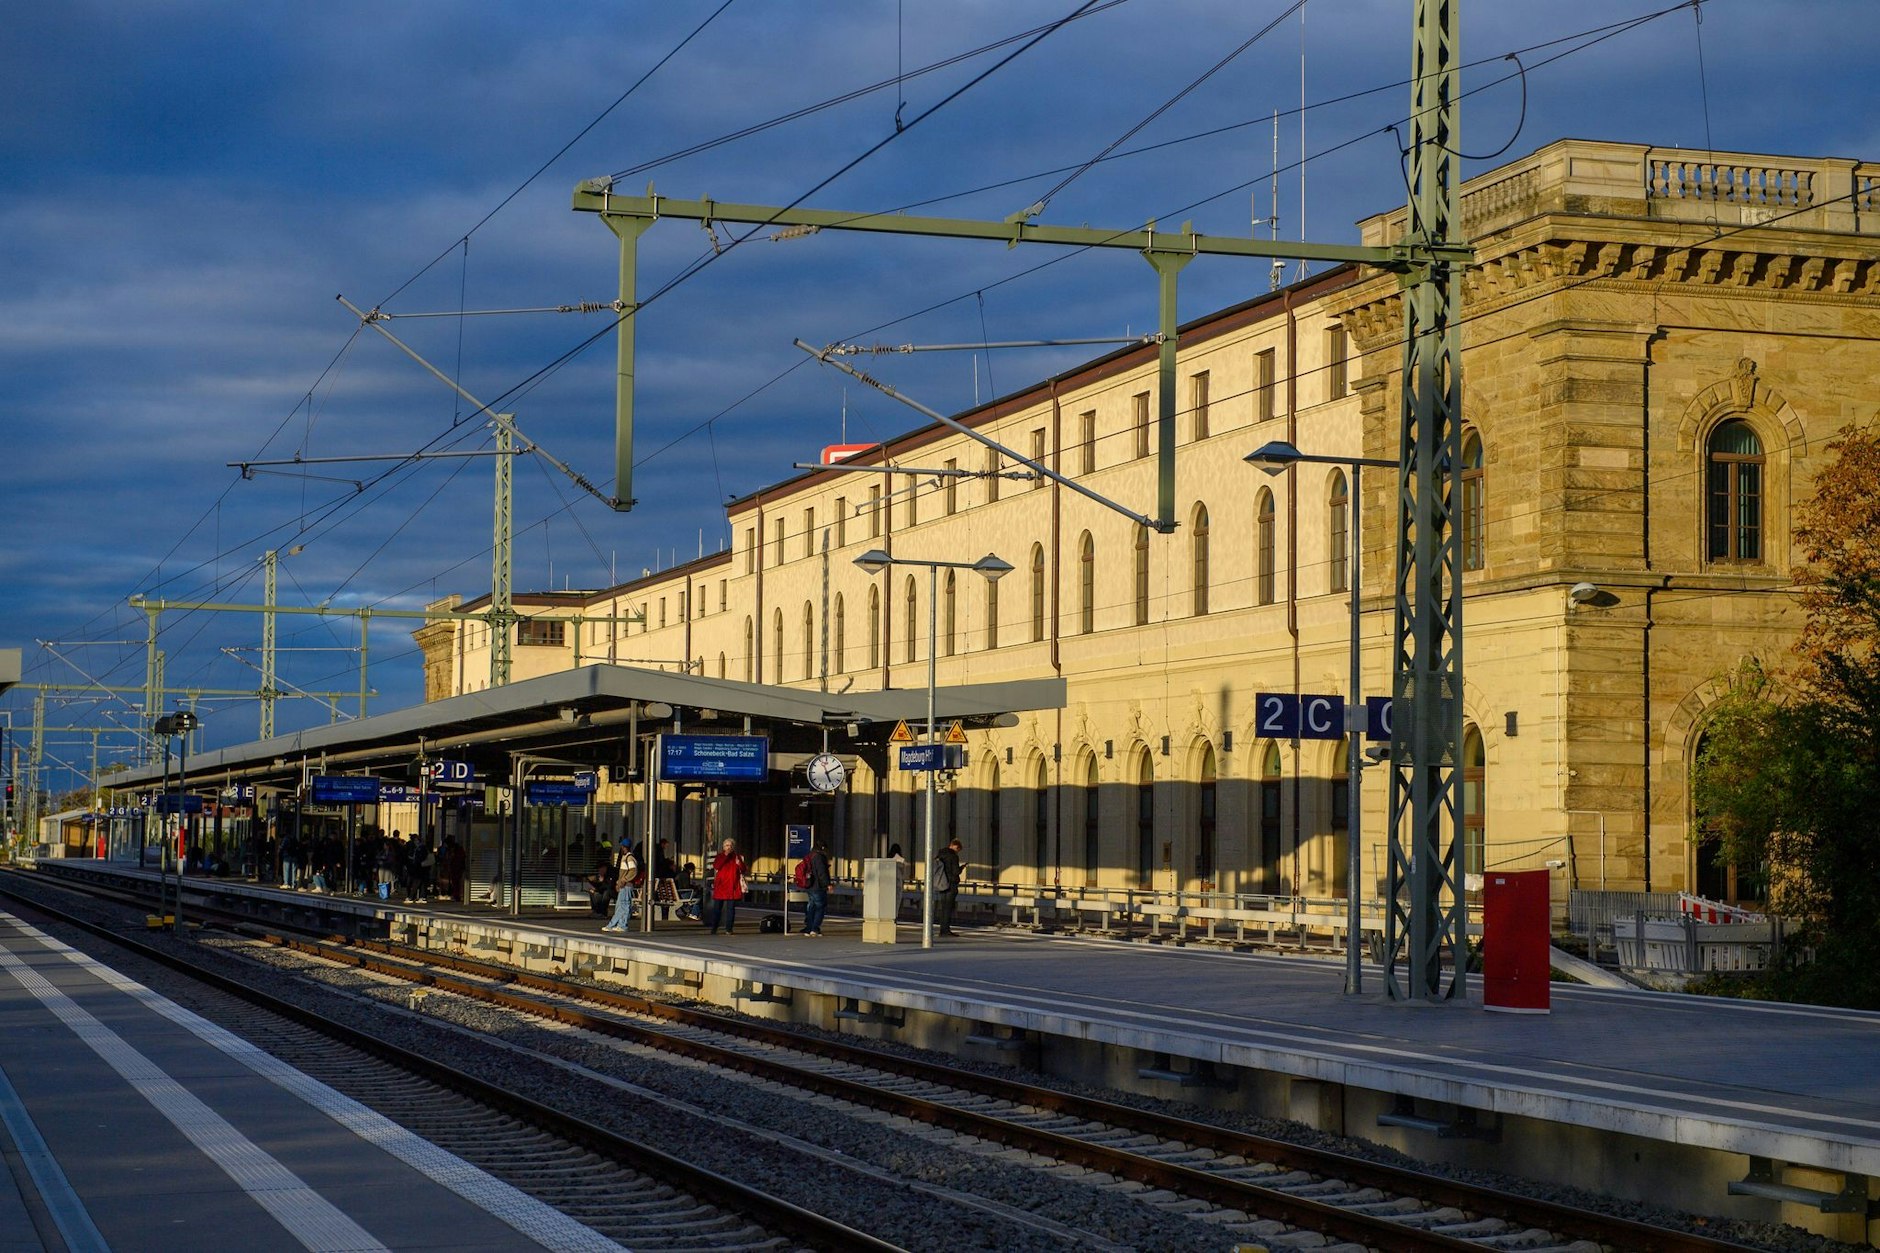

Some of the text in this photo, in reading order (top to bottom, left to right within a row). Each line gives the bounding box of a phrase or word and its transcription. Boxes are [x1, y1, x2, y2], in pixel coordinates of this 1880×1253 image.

[1263, 696, 1332, 733] 2 C
[435, 762, 469, 779] 2 D
[245, 786, 253, 798] E
[141, 796, 148, 806] 2
